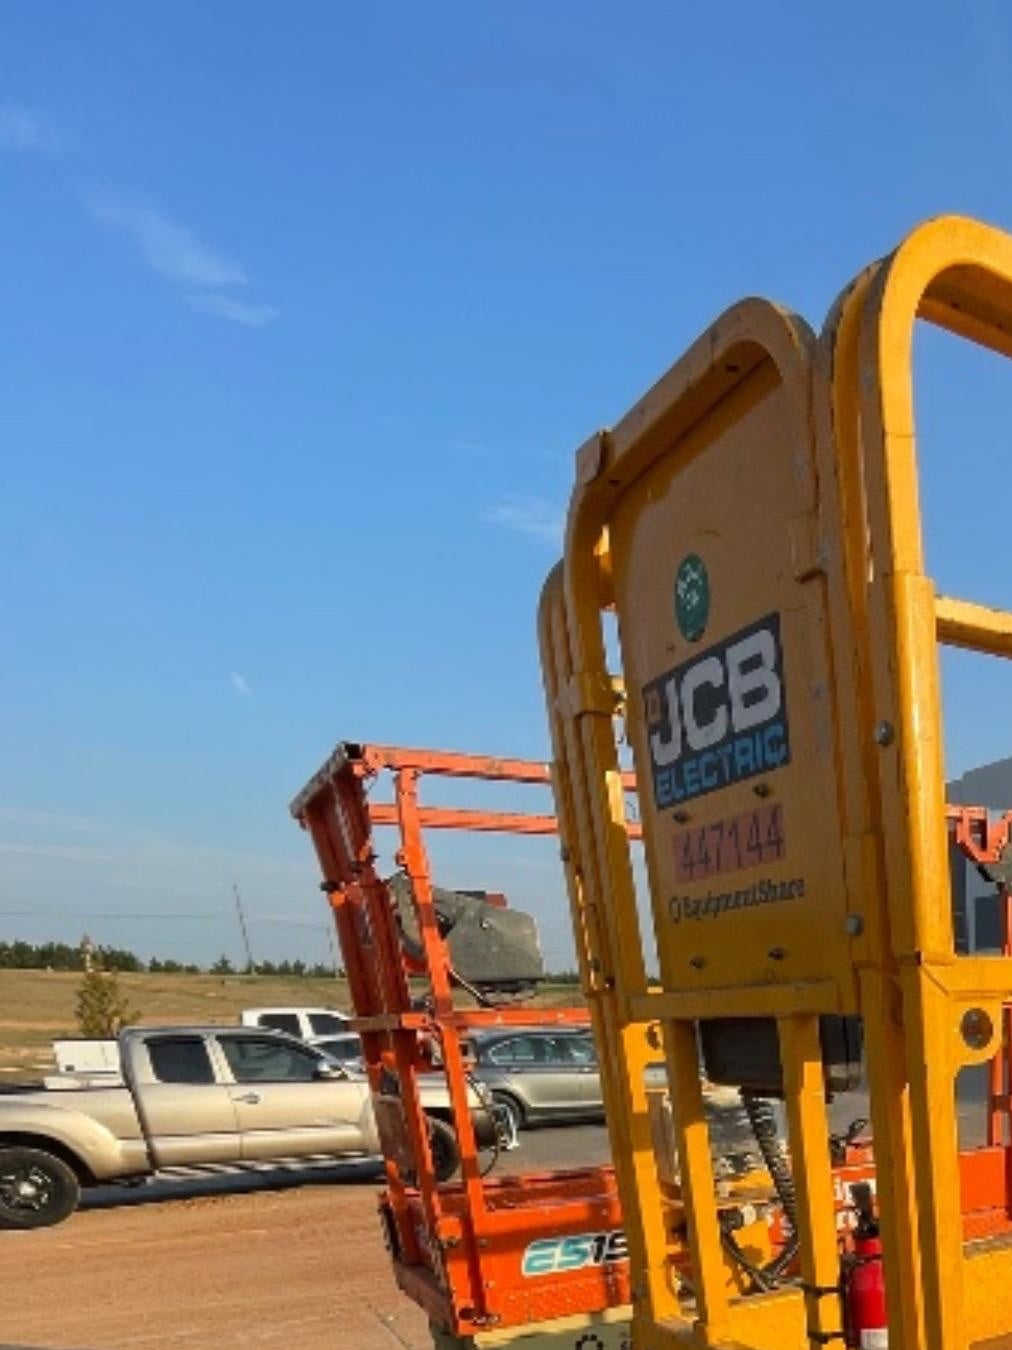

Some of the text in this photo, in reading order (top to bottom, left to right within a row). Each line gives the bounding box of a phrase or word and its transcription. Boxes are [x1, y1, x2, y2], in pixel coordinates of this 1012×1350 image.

[650, 628, 782, 767] JCB
[656, 723, 788, 806] ELECTRIC
[681, 803, 783, 879] 447144
[683, 878, 805, 921] EquipmentShare
